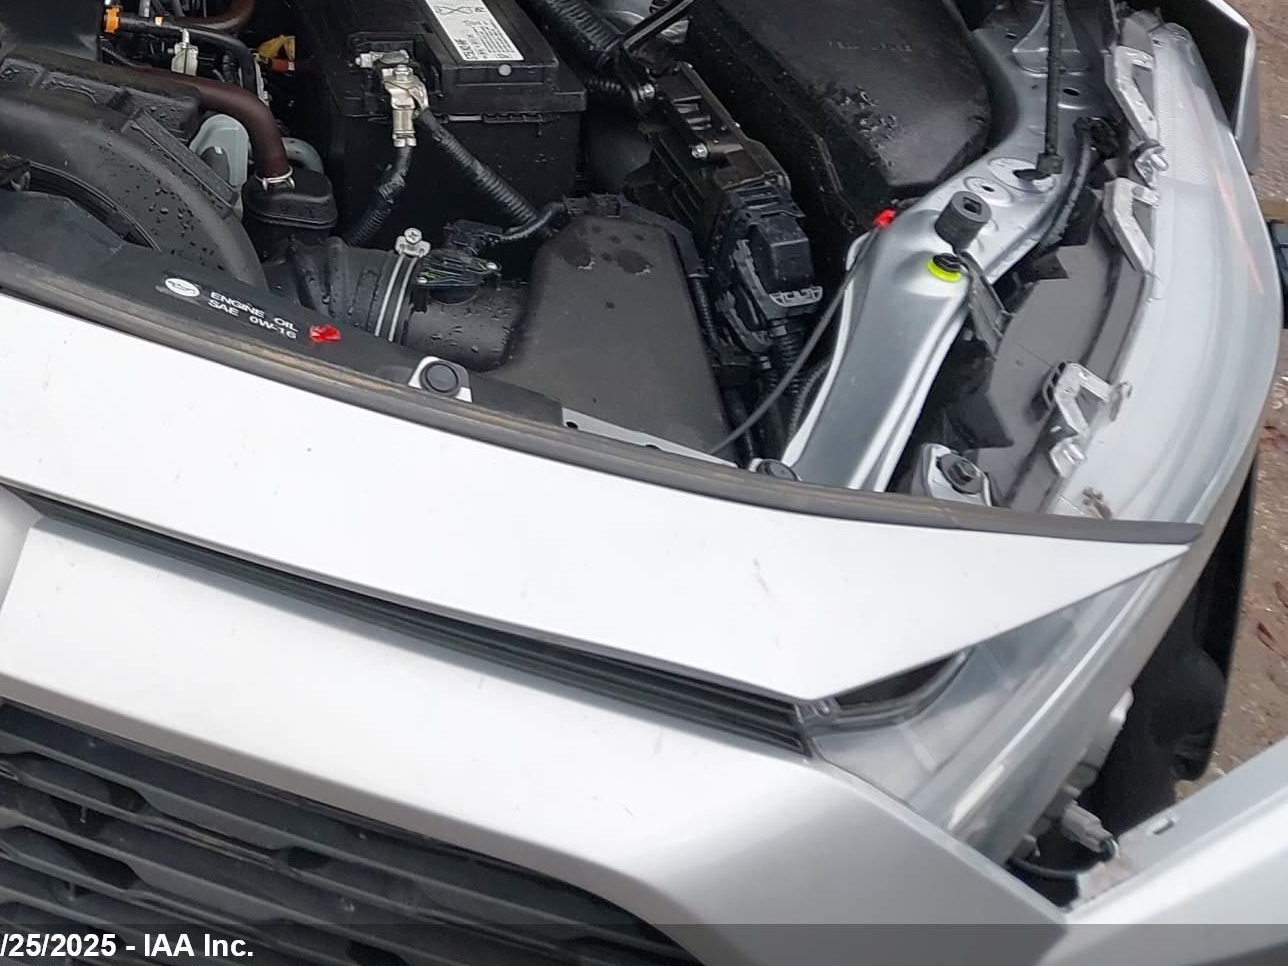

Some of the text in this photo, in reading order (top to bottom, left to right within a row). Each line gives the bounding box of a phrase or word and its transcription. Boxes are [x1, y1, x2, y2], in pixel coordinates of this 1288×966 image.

[208, 299, 297, 339] SAE 0W-16
[210, 291, 299, 332] ENGINE OIL
